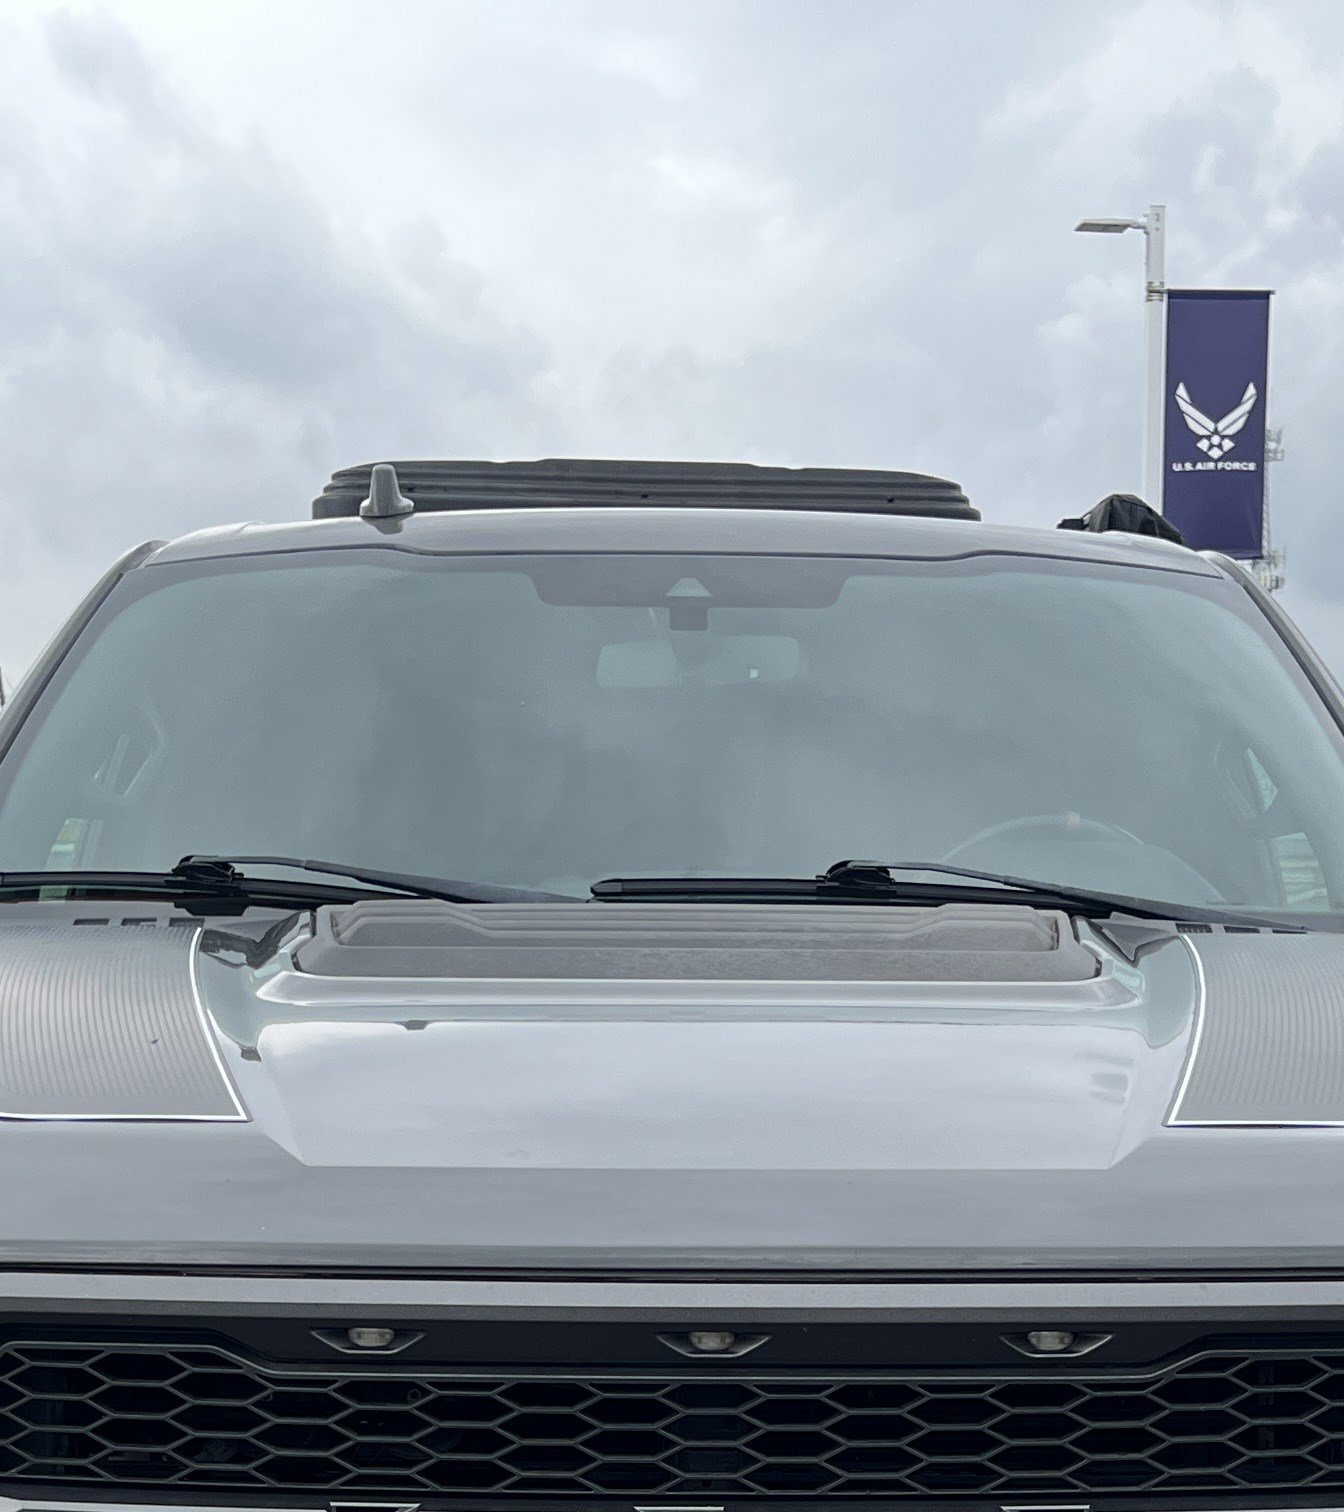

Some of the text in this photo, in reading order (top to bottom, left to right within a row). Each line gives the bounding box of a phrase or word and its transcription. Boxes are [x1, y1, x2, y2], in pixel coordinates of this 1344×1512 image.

[1172, 462, 1257, 472] U.S. AIR FORCE
